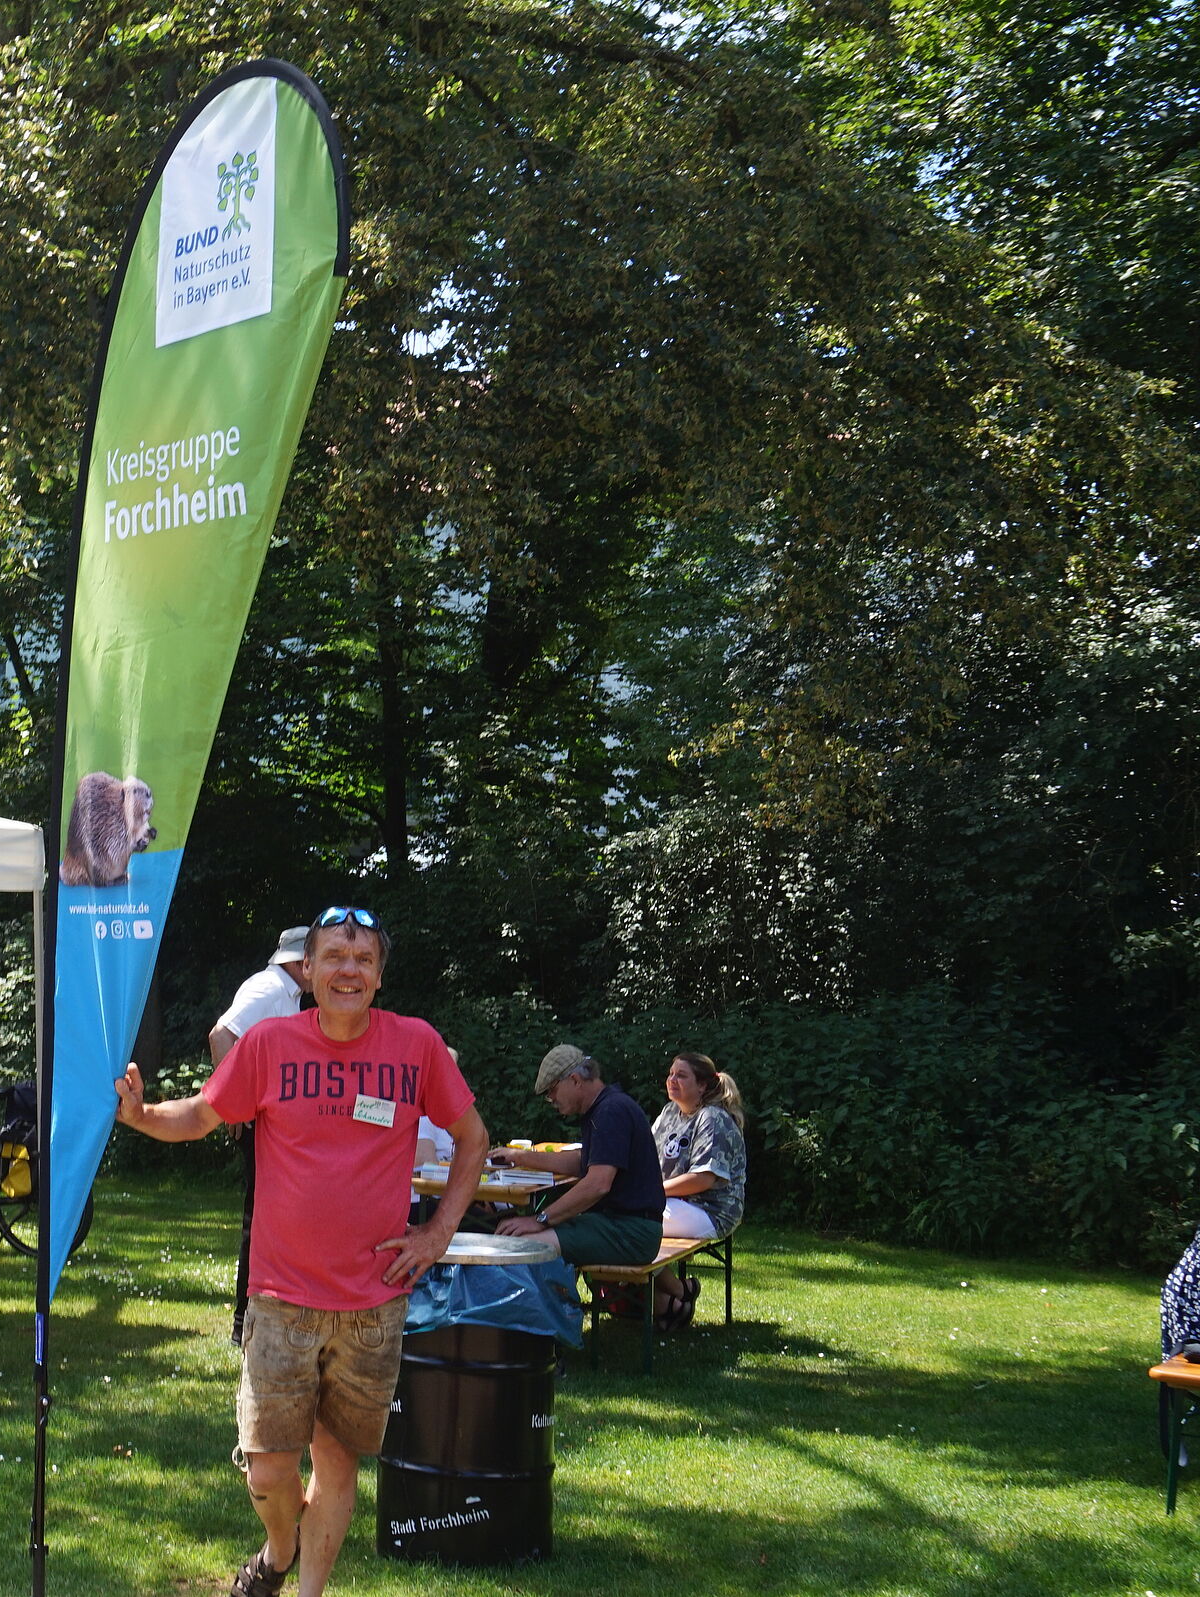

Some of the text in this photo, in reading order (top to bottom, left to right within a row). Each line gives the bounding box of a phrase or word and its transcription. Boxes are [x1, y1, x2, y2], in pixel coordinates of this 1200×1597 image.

[174, 226, 219, 258] BUND
[174, 244, 251, 285] Naturschutz
[173, 267, 251, 309] in Bayern e.V.
[106, 425, 241, 487] Kreisgruppe
[104, 474, 247, 544] Forchheim
[278, 1060, 419, 1106] BOSTON
[390, 1508, 490, 1535] Stadt Forchheim
